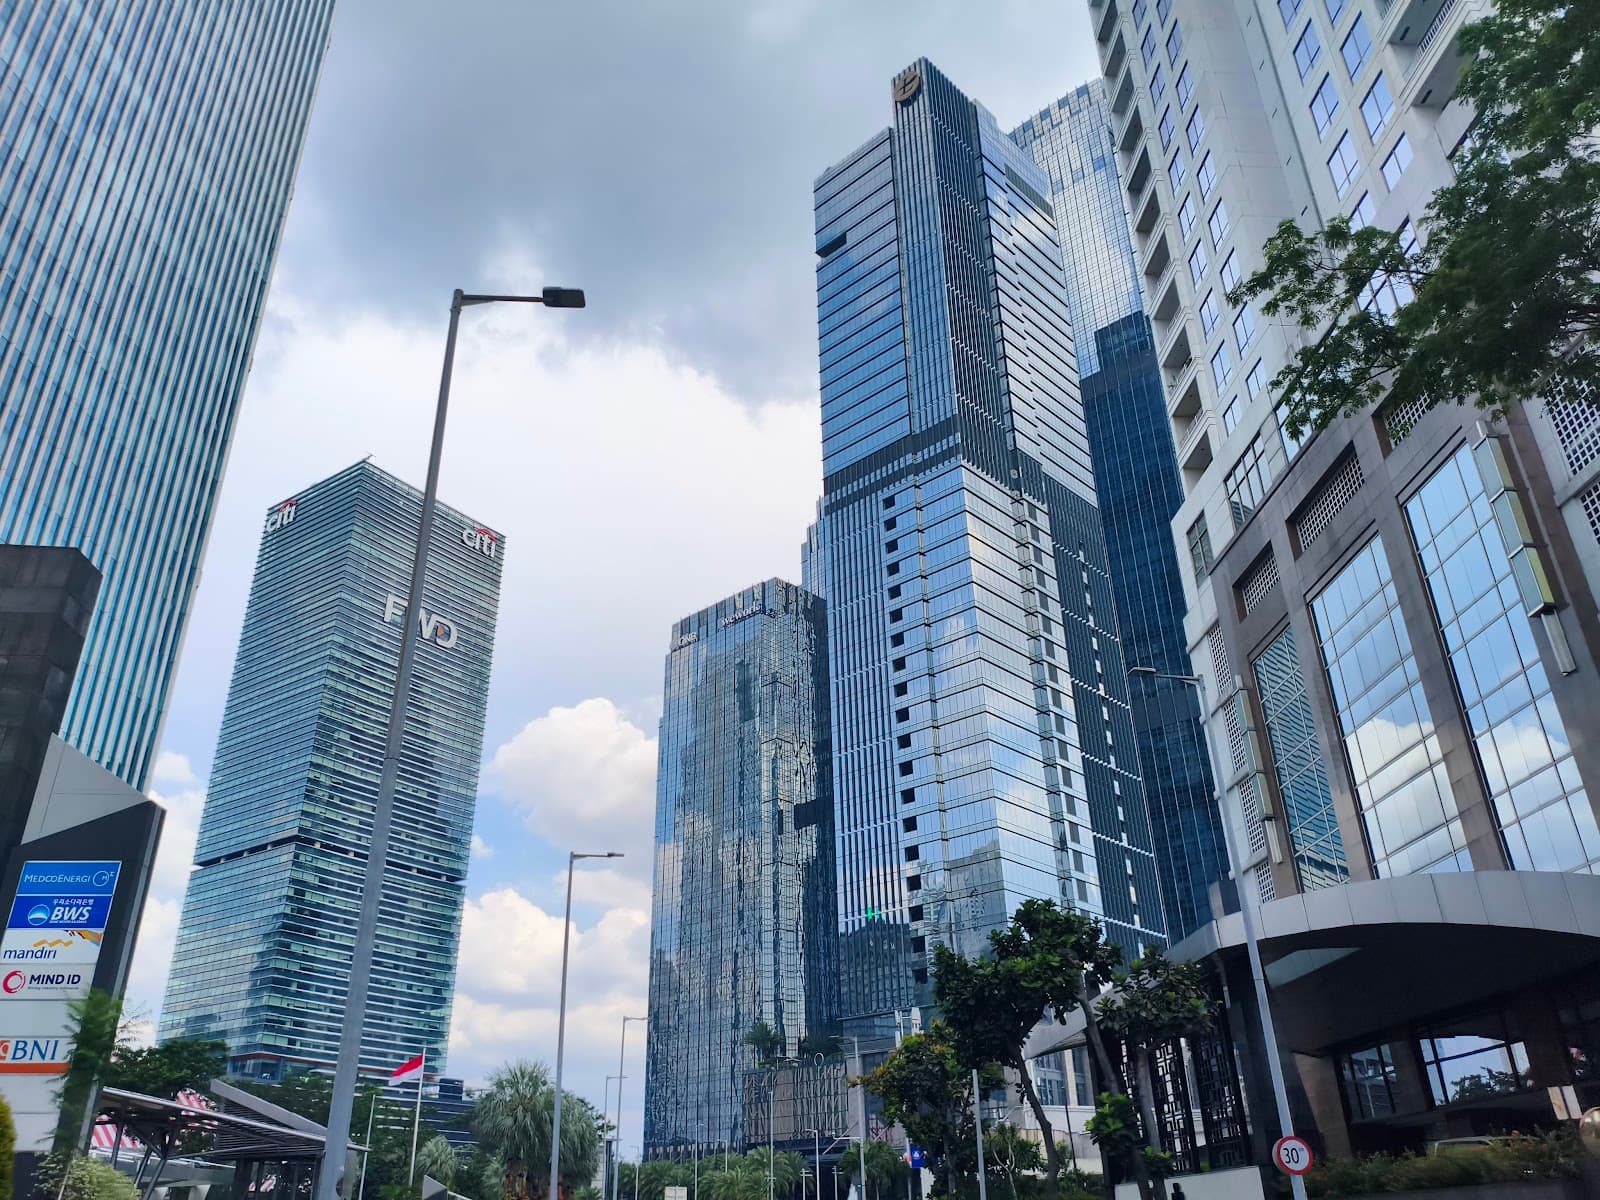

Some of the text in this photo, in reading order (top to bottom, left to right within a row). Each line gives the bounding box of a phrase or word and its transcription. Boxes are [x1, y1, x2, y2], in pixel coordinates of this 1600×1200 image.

[266, 500, 297, 532] citi
[462, 528, 497, 558] citi
[50, 906, 92, 920] BWS
[3, 947, 56, 959] mandiri
[29, 974, 81, 984] MIND ID
[11, 1040, 59, 1061] BNI
[1283, 1148, 1299, 1163] 30
